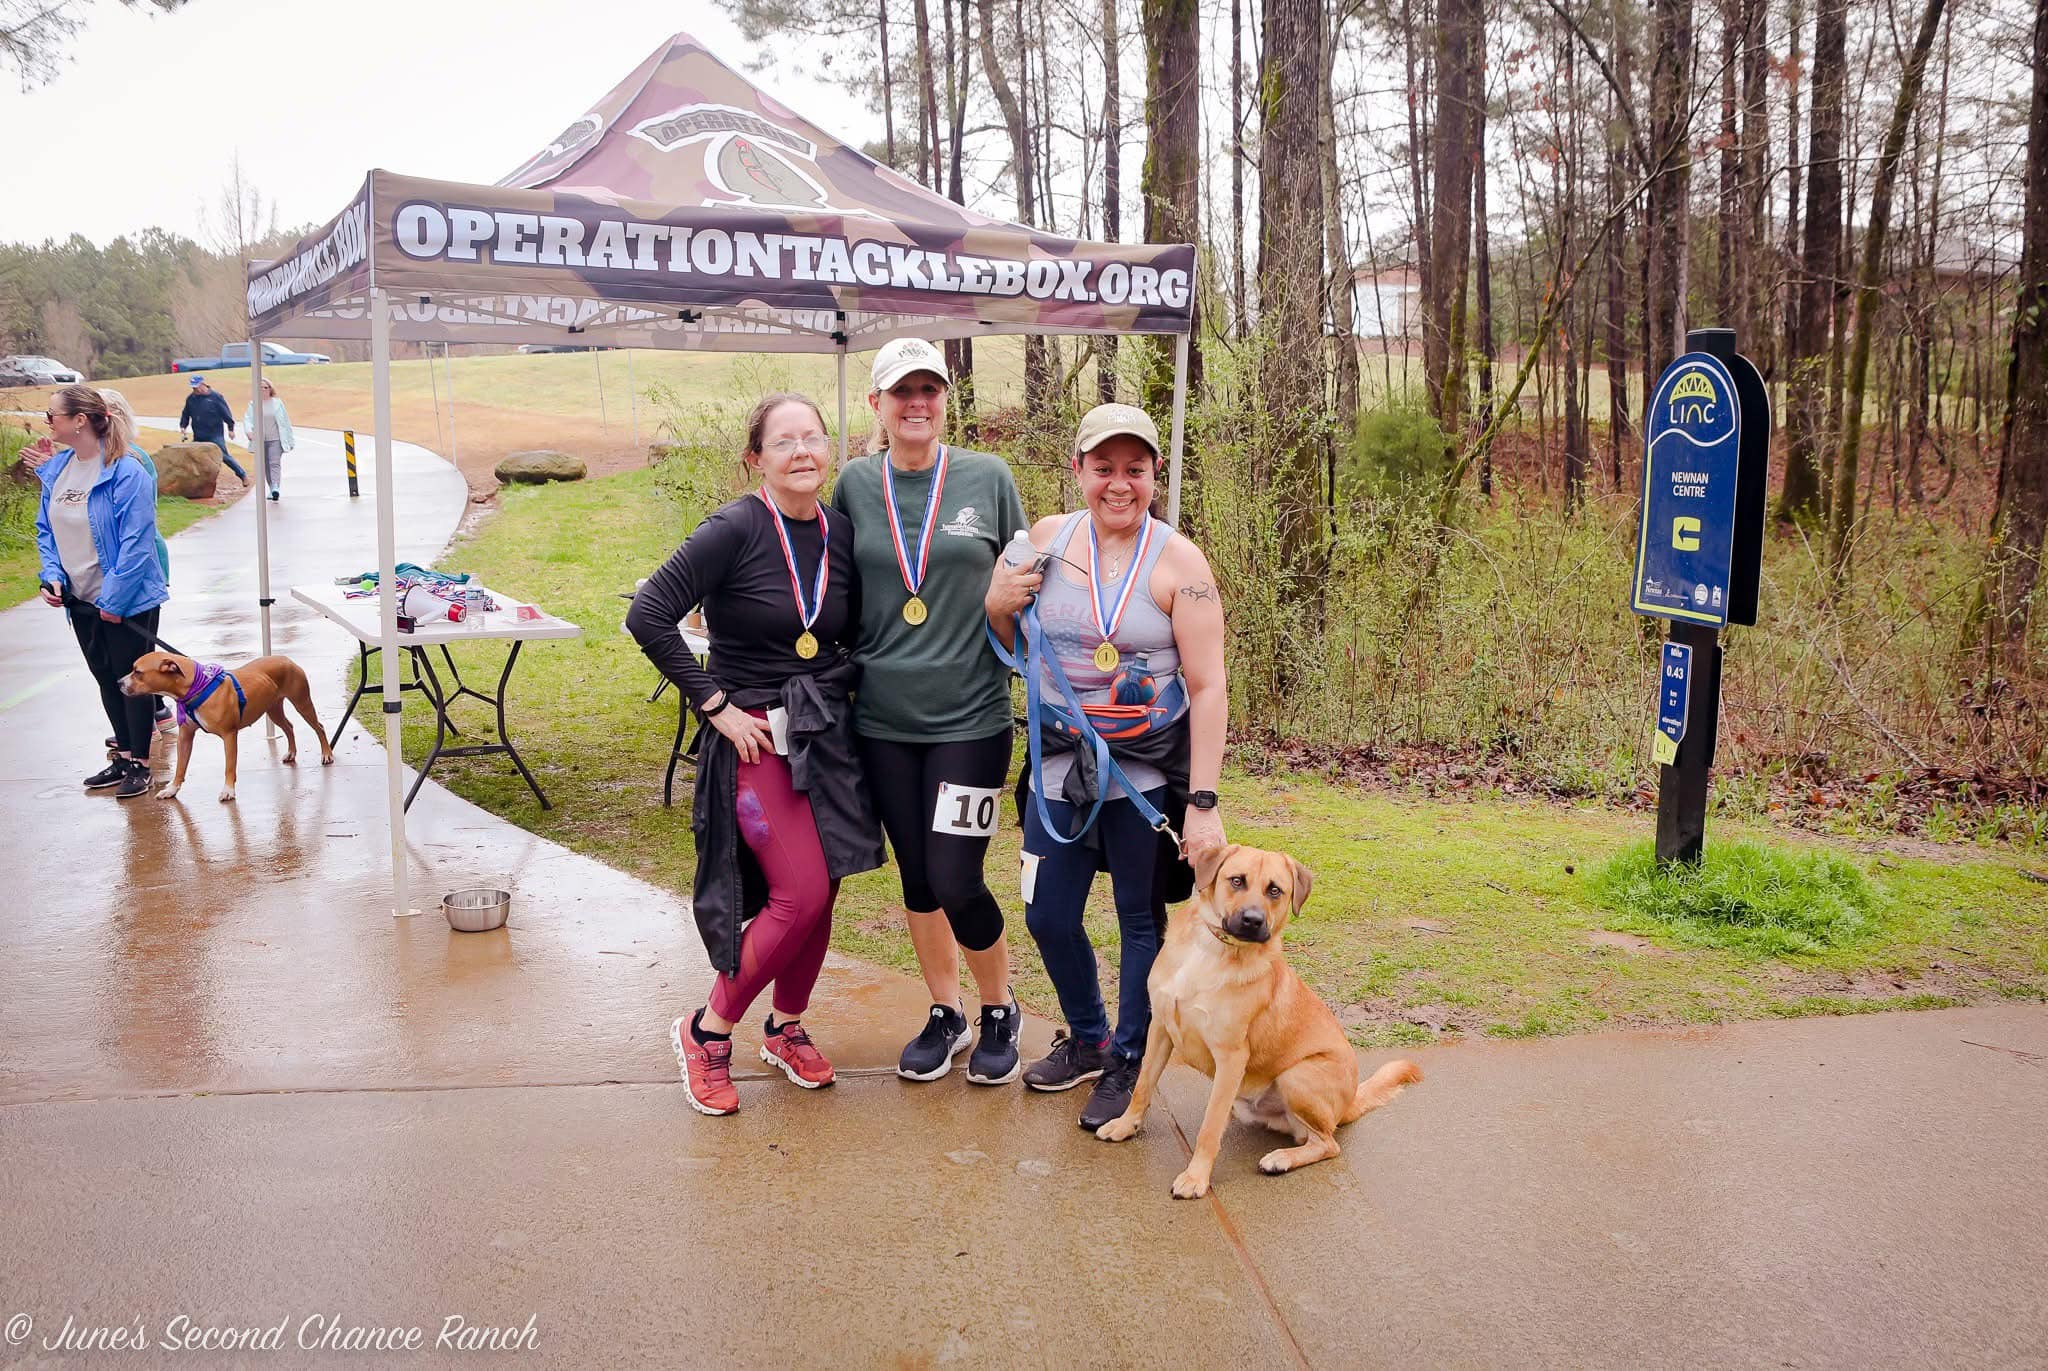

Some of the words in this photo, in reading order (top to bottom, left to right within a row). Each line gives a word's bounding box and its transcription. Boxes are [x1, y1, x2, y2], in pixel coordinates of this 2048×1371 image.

[661, 110, 801, 148] OPERATION
[333, 200, 367, 273] BOX
[396, 203, 1190, 308] OPERATIONTACKLEBOX.ORG
[1670, 403, 1715, 424] LINC
[1671, 471, 1709, 484] NEWNAN
[1672, 485, 1706, 498] CENTRE
[1666, 664, 1684, 680] 0.43
[951, 795, 994, 830] 10
